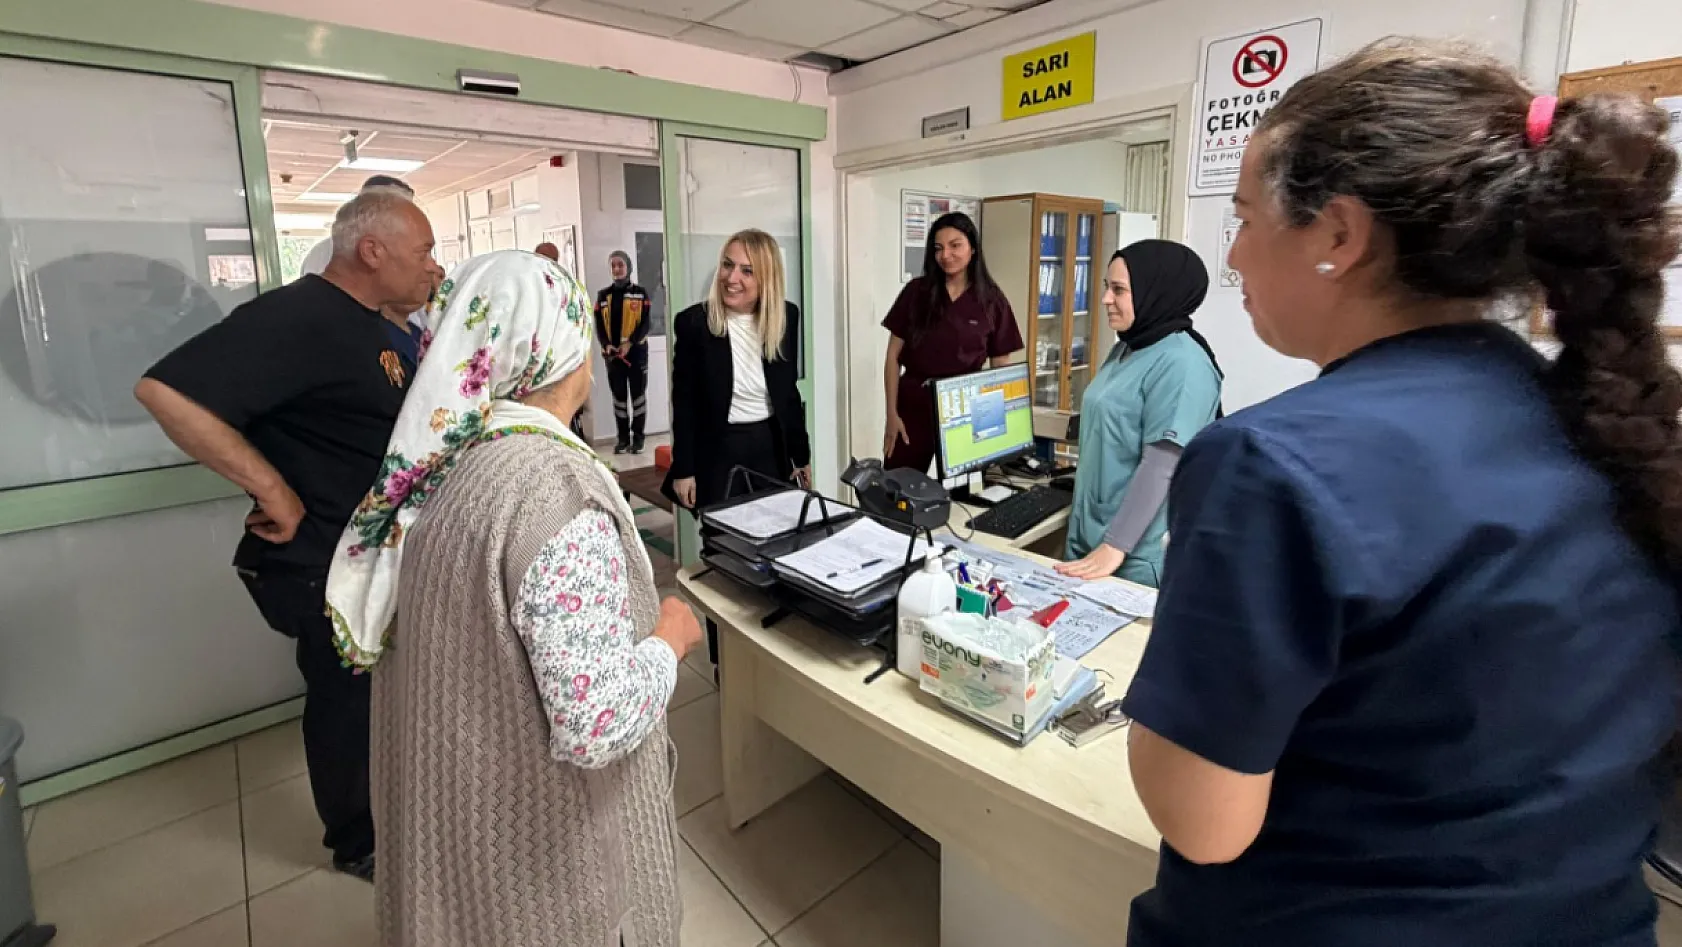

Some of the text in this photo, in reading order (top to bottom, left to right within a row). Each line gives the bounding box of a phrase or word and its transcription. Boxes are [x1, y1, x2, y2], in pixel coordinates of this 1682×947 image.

[1023, 51, 1069, 78] SARI
[1019, 80, 1072, 108] ALAN
[1203, 154, 1217, 163] NO
[922, 630, 982, 667] evony
